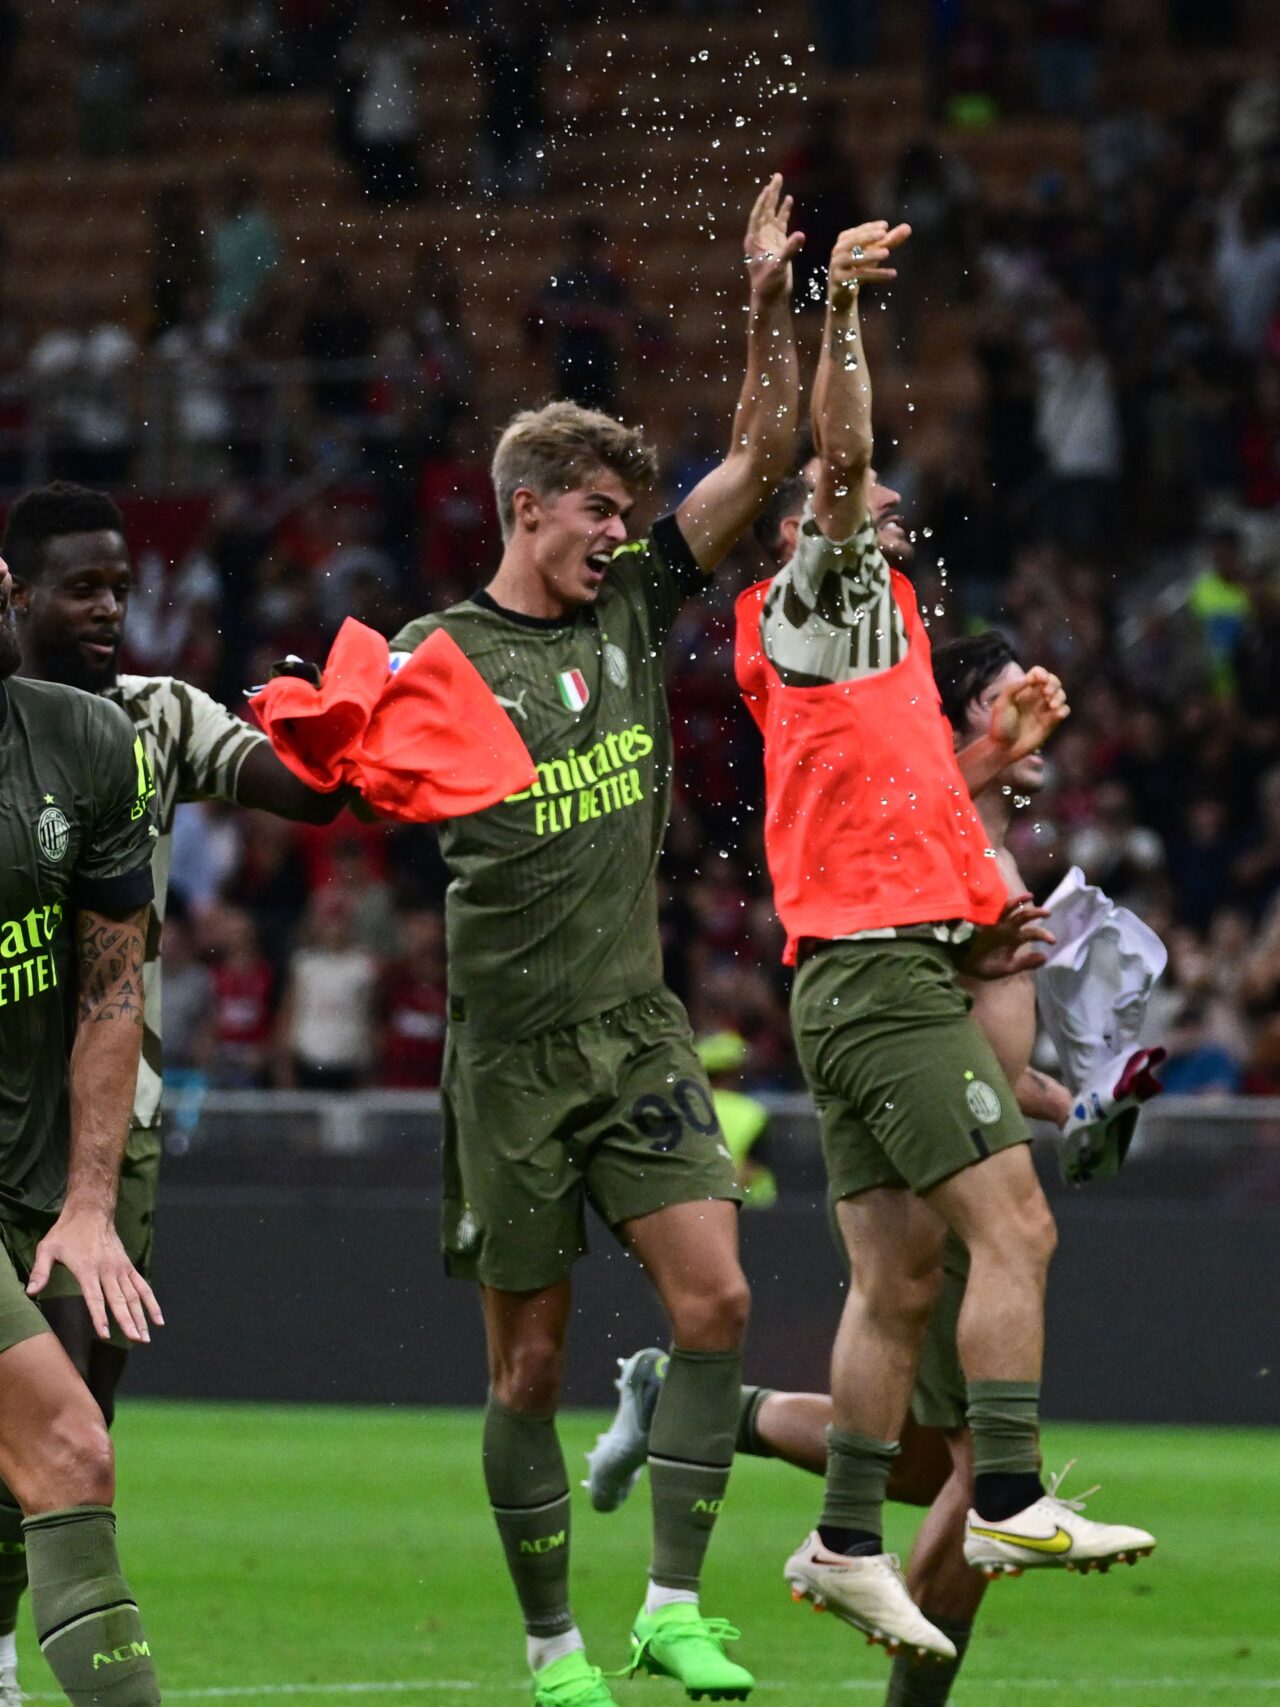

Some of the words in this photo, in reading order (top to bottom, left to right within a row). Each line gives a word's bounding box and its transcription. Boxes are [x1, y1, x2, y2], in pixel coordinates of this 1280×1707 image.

[505, 724, 653, 802] mirates
[535, 796, 572, 835] FLY
[579, 768, 644, 823] BETTER
[632, 1079, 719, 1153] 90
[520, 1529, 565, 1553] ACM
[92, 1641, 150, 1670] ACM
